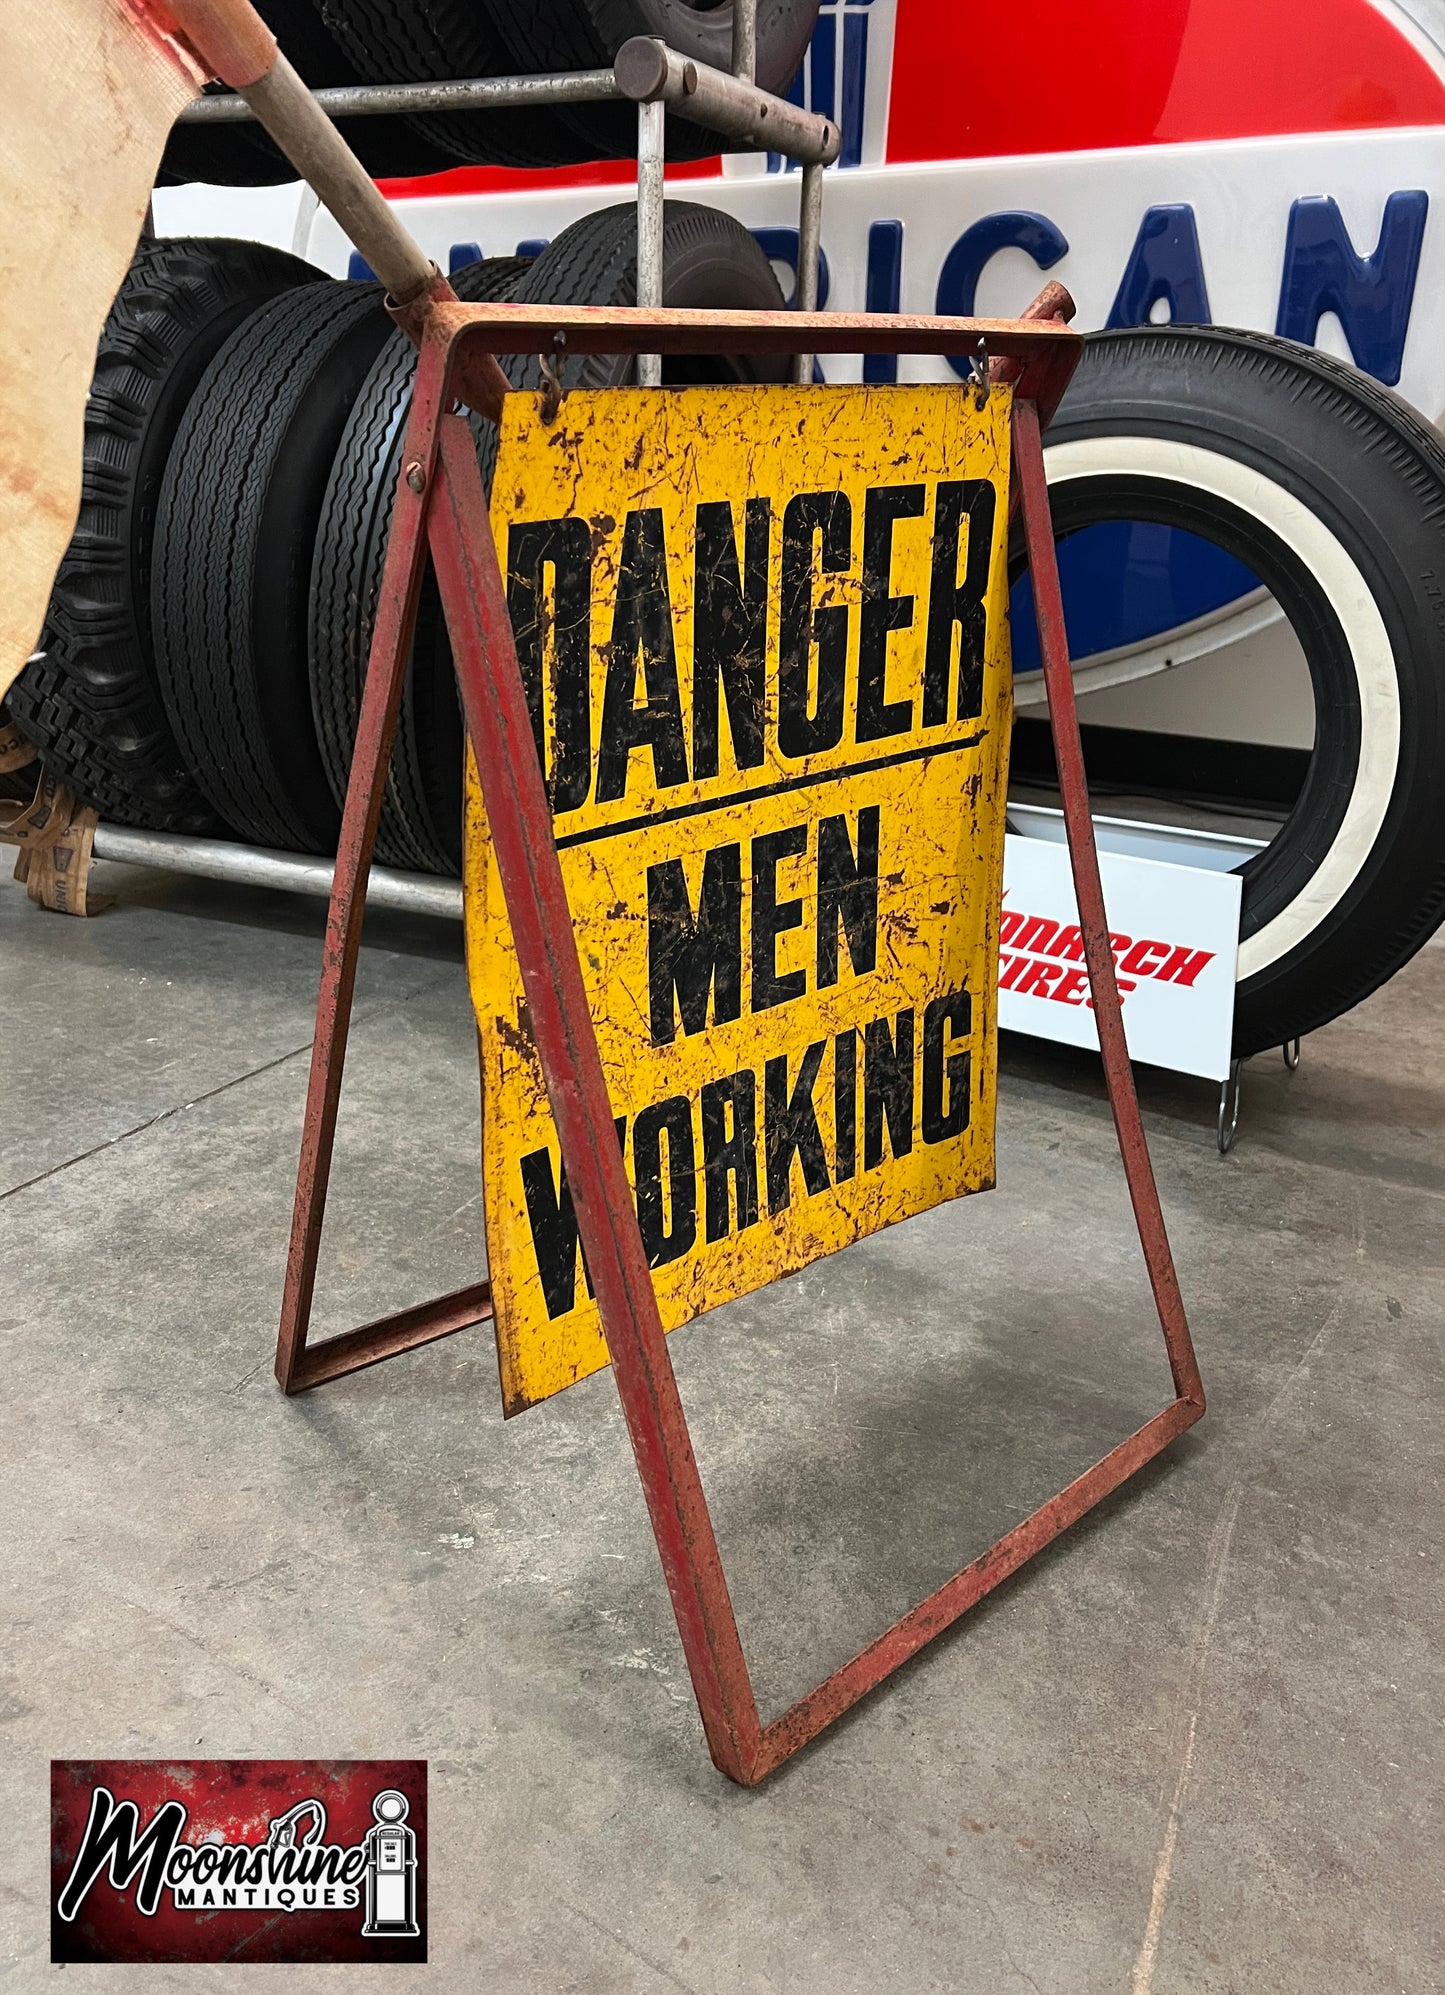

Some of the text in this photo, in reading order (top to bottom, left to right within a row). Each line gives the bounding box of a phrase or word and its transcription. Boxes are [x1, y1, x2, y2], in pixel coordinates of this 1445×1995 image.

[506, 478, 997, 816] DANGER
[647, 804, 880, 1048] MEN
[998, 952, 1137, 1009] IRE
[999, 910, 1218, 987] ONACH
